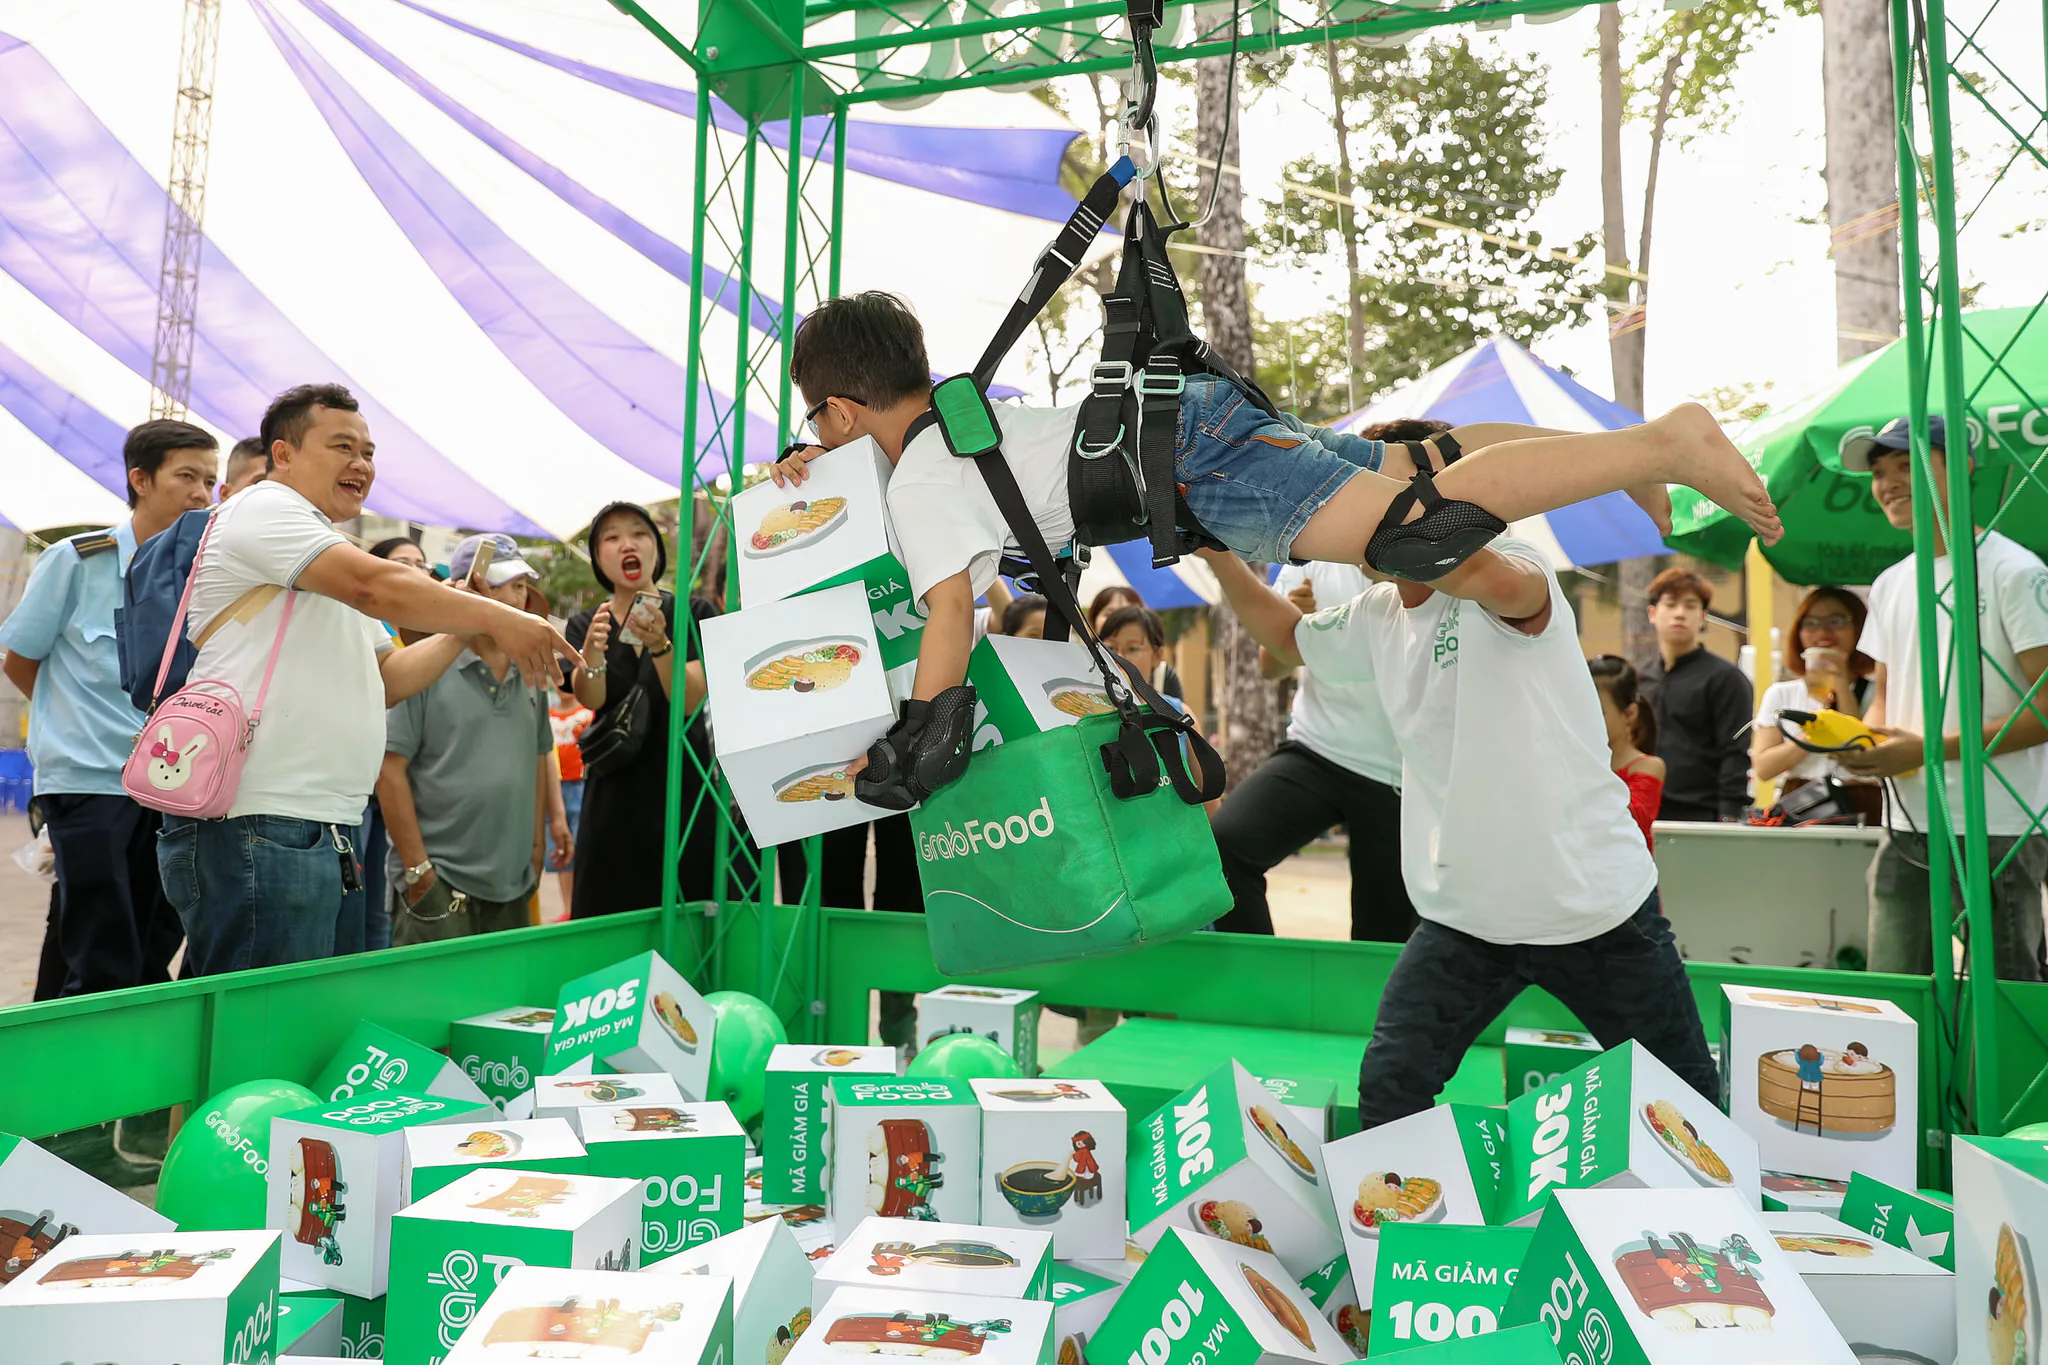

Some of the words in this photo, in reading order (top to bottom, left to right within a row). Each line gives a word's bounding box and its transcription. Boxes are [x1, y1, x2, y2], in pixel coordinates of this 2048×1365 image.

[918, 796, 1055, 863] GrabFood
[558, 978, 640, 1033] 30K
[613, 1015, 634, 1034] MÃ
[554, 1037, 576, 1056] GIÁ
[330, 1045, 389, 1103] Foo
[461, 1054, 529, 1090] Grab
[851, 1081, 949, 1092] Grab
[1584, 1065, 1602, 1097] MÃ
[321, 1095, 423, 1121] Food
[349, 1101, 446, 1125] Grab
[791, 1082, 809, 1112] GIÁ
[854, 1091, 953, 1101] Food
[789, 1116, 808, 1162] GIẢM
[1148, 1113, 1165, 1141] GIÁ
[1173, 1084, 1214, 1188] 30K
[1475, 1119, 1496, 1156] GIÁ
[1527, 1082, 1573, 1202] 30K
[205, 1110, 269, 1183] GrabFoo
[1580, 1144, 1599, 1179] GIÁ
[642, 1174, 722, 1212] Foo
[788, 1165, 807, 1193] MÃ
[1152, 1177, 1168, 1206] MÃ
[641, 1218, 721, 1253] Gra
[1391, 1259, 1429, 1281] MÃ
[1434, 1261, 1498, 1286] GIẢM
[427, 1249, 479, 1365] rab
[1540, 1250, 1590, 1346] Foo
[1202, 1317, 1231, 1357] MÃ
[1389, 1300, 1504, 1342] 100
